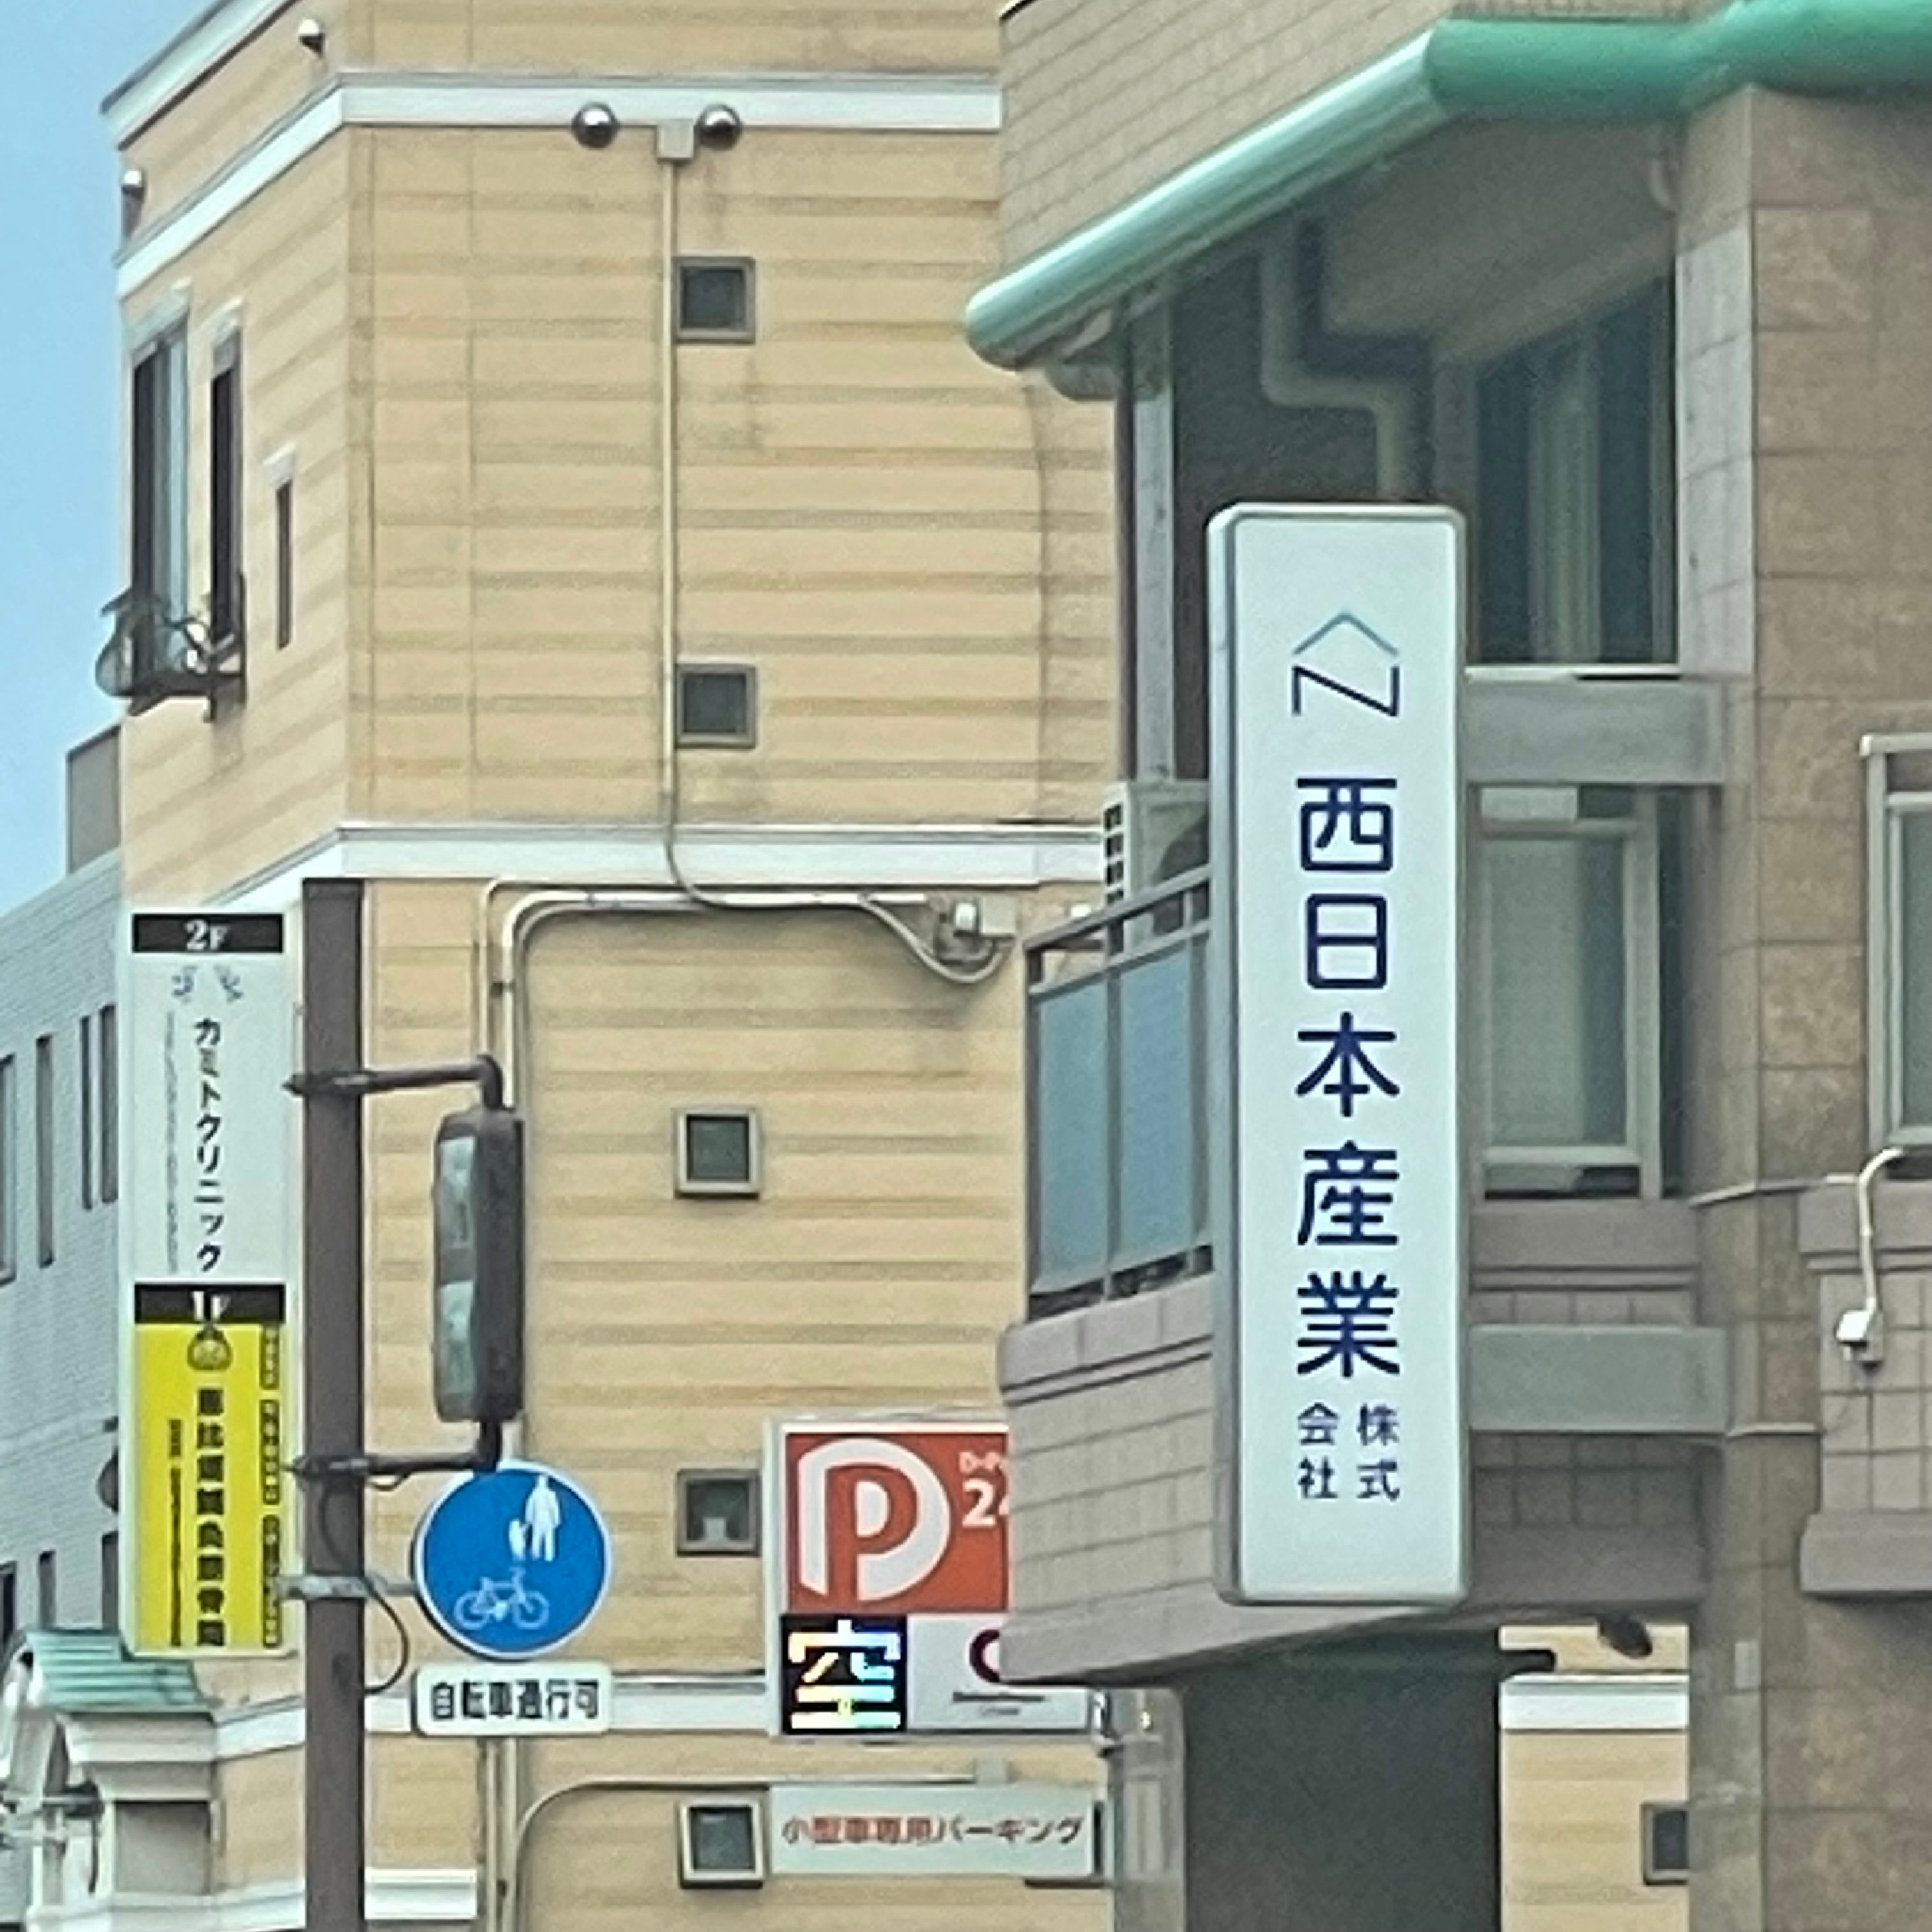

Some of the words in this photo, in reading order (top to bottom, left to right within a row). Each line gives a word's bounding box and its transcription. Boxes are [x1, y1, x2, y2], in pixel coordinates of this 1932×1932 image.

[183, 919, 230, 951] 2F
[1296, 778, 1401, 1379] 西日本産業
[194, 1017, 224, 1272] カミトクリニック
[1297, 1402, 1339, 1500] 会社
[1355, 1404, 1401, 1501] 株式
[797, 1438, 951, 1602] P
[431, 1679, 599, 1720] 自転車通行可
[787, 1619, 901, 1729] 空
